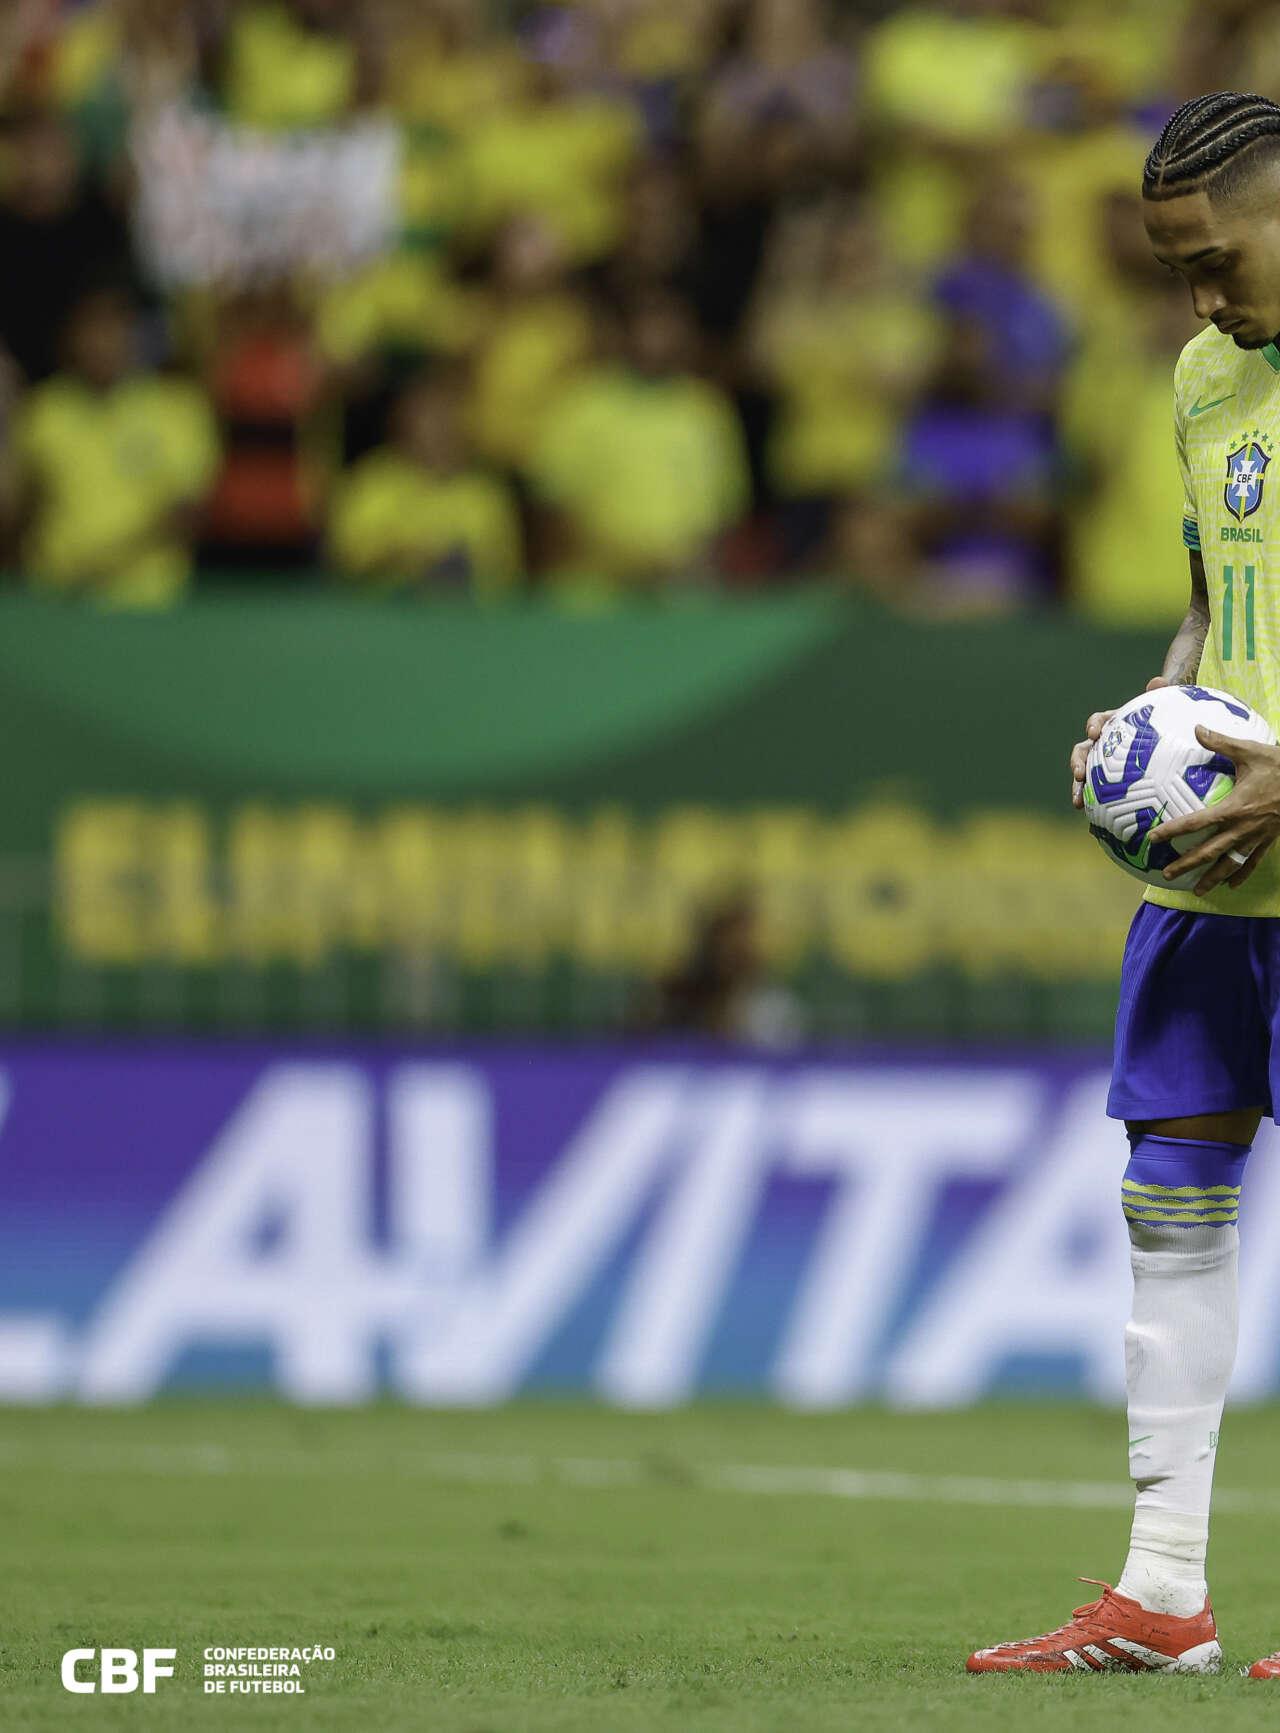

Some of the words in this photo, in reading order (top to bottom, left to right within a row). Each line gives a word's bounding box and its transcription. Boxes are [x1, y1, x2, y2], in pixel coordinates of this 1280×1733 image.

[1236, 473, 1252, 483] CBF
[1220, 527, 1264, 543] BRASIL
[1222, 565, 1256, 661] 11
